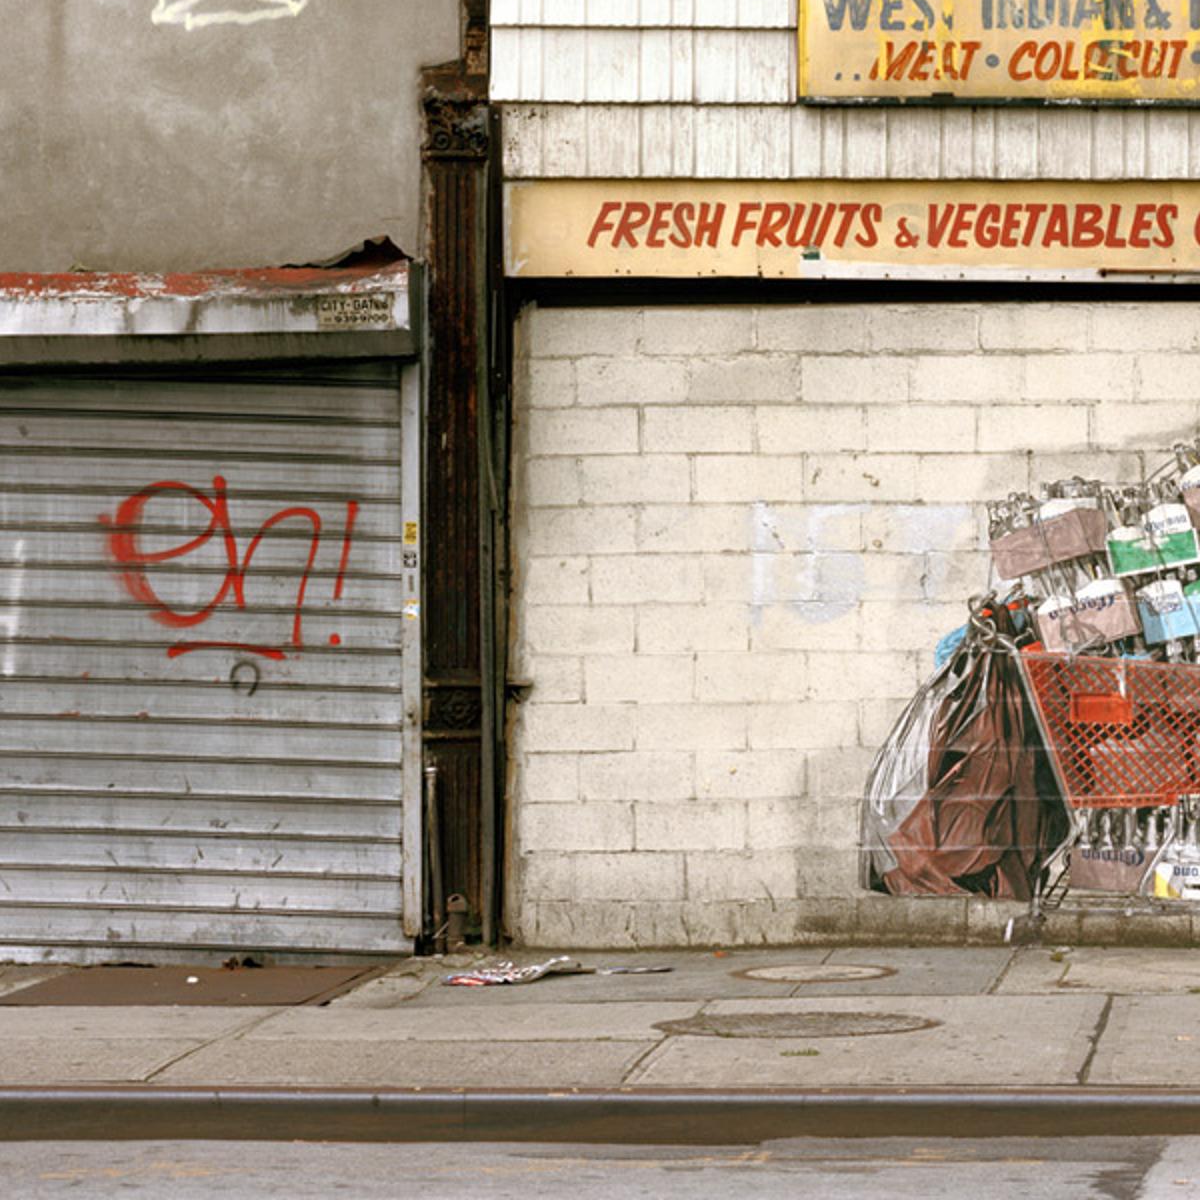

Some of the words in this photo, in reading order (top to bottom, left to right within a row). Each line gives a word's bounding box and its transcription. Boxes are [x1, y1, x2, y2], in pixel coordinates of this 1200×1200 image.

[587, 201, 726, 249] FRESH
[731, 202, 883, 249] FRUITS
[894, 215, 920, 248] &
[926, 202, 1179, 249] VEGETABLES
